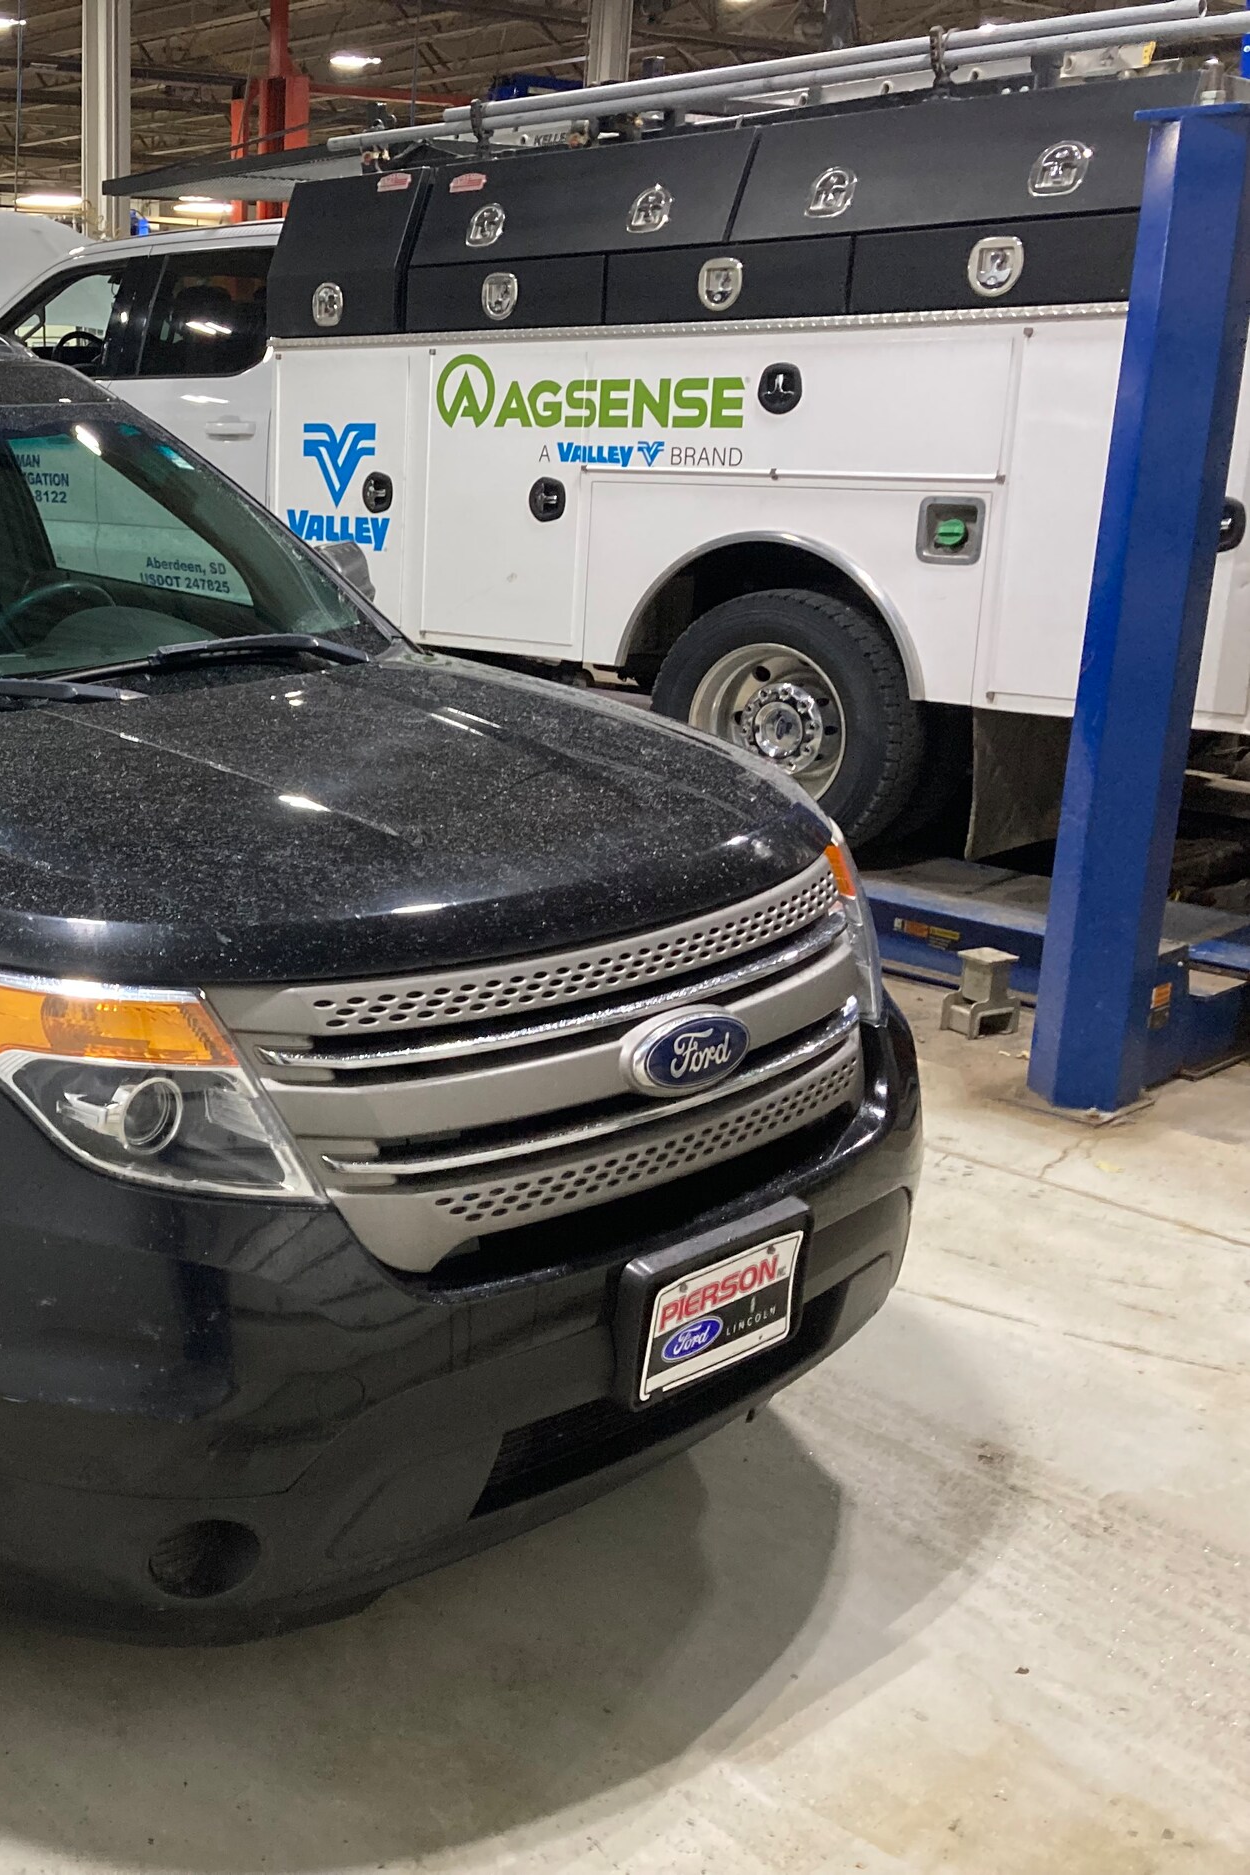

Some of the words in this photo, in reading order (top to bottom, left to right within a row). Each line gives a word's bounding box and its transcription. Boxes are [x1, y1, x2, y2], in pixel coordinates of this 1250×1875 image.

[534, 132, 566, 146] KELLE
[494, 377, 746, 429] AGSENSE
[539, 444, 551, 463] A
[557, 442, 634, 467] VALLEY
[670, 446, 743, 467] BRAND
[24, 472, 70, 488] GATION
[287, 509, 390, 551] VALLEY
[146, 556, 207, 576] Aberdeen,
[209, 561, 227, 575] SD
[185, 577, 231, 594] 247825
[670, 1028, 731, 1079] Ford
[658, 1254, 780, 1334] PIERSON
[726, 1305, 777, 1337] LINCOLN
[673, 1325, 711, 1356] Ford
